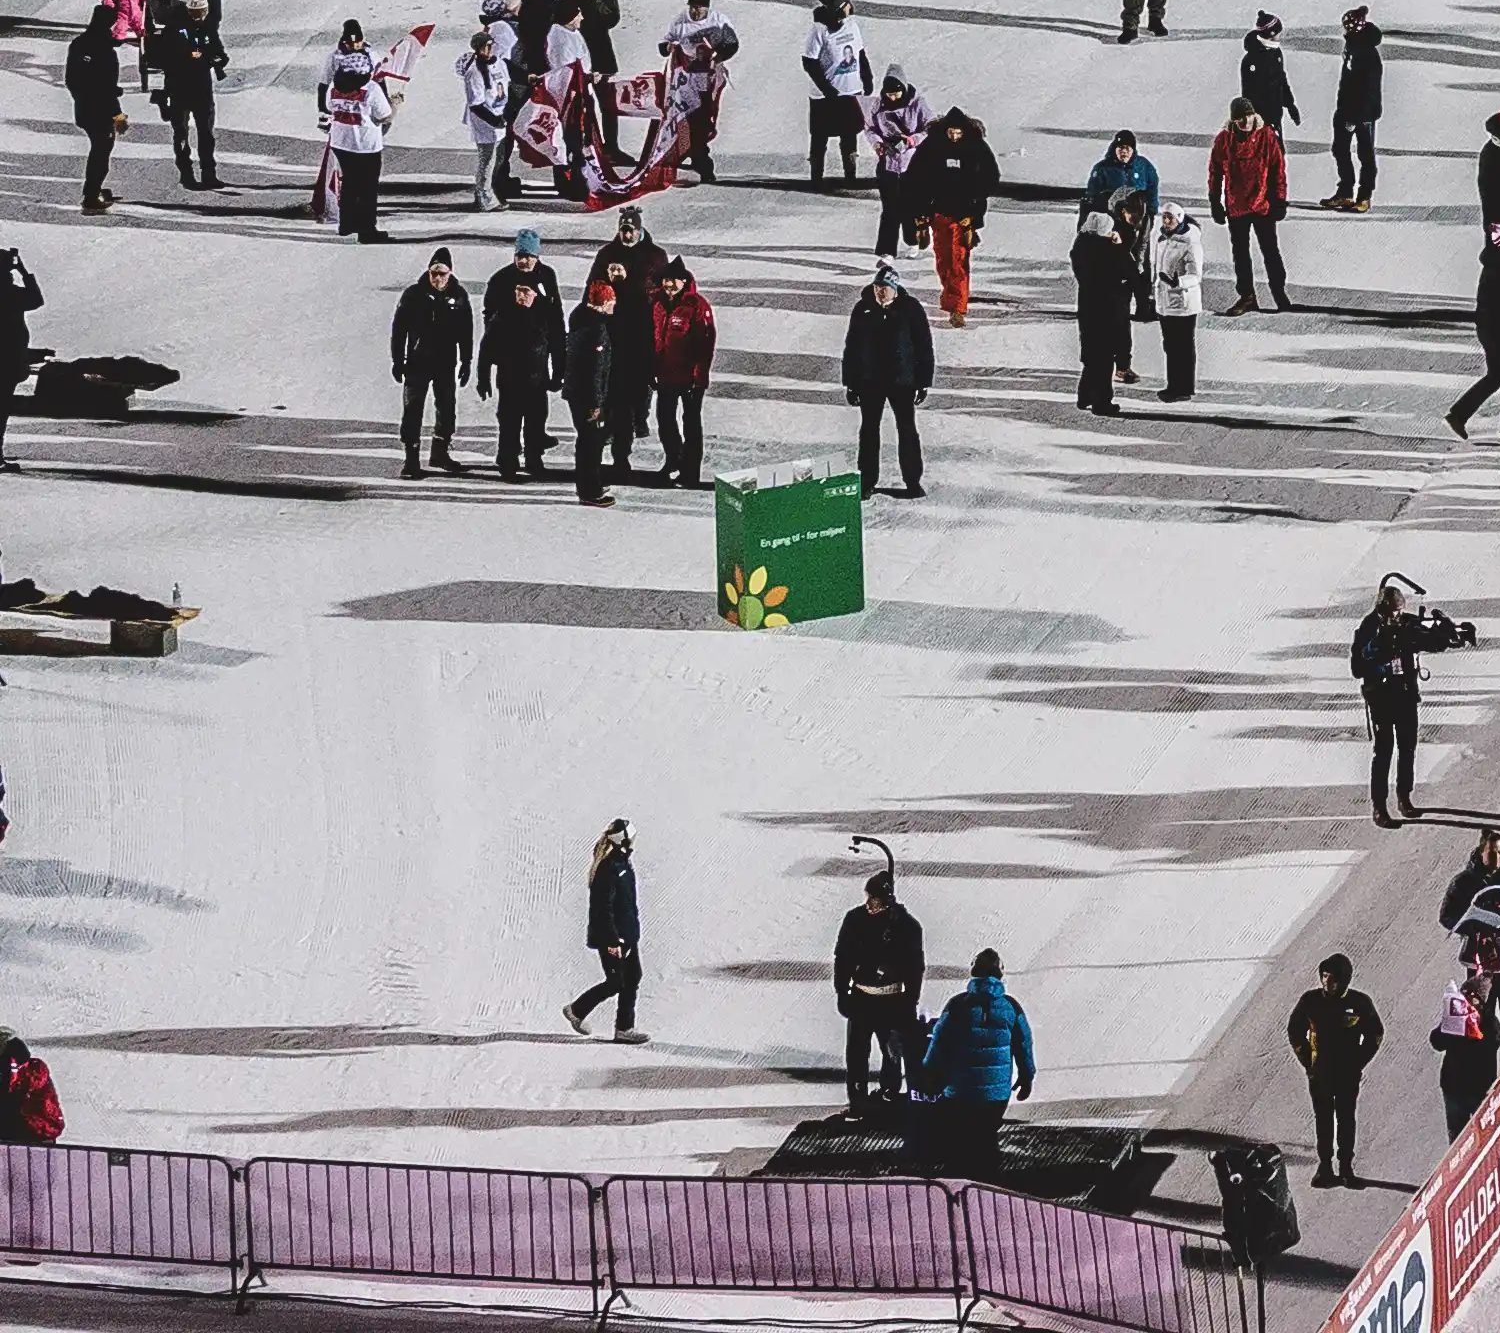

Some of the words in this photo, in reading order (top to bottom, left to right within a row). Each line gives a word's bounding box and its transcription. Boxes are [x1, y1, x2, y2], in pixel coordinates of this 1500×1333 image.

[761, 538, 772, 548] En
[772, 536, 792, 549] gang
[806, 531, 819, 540] for
